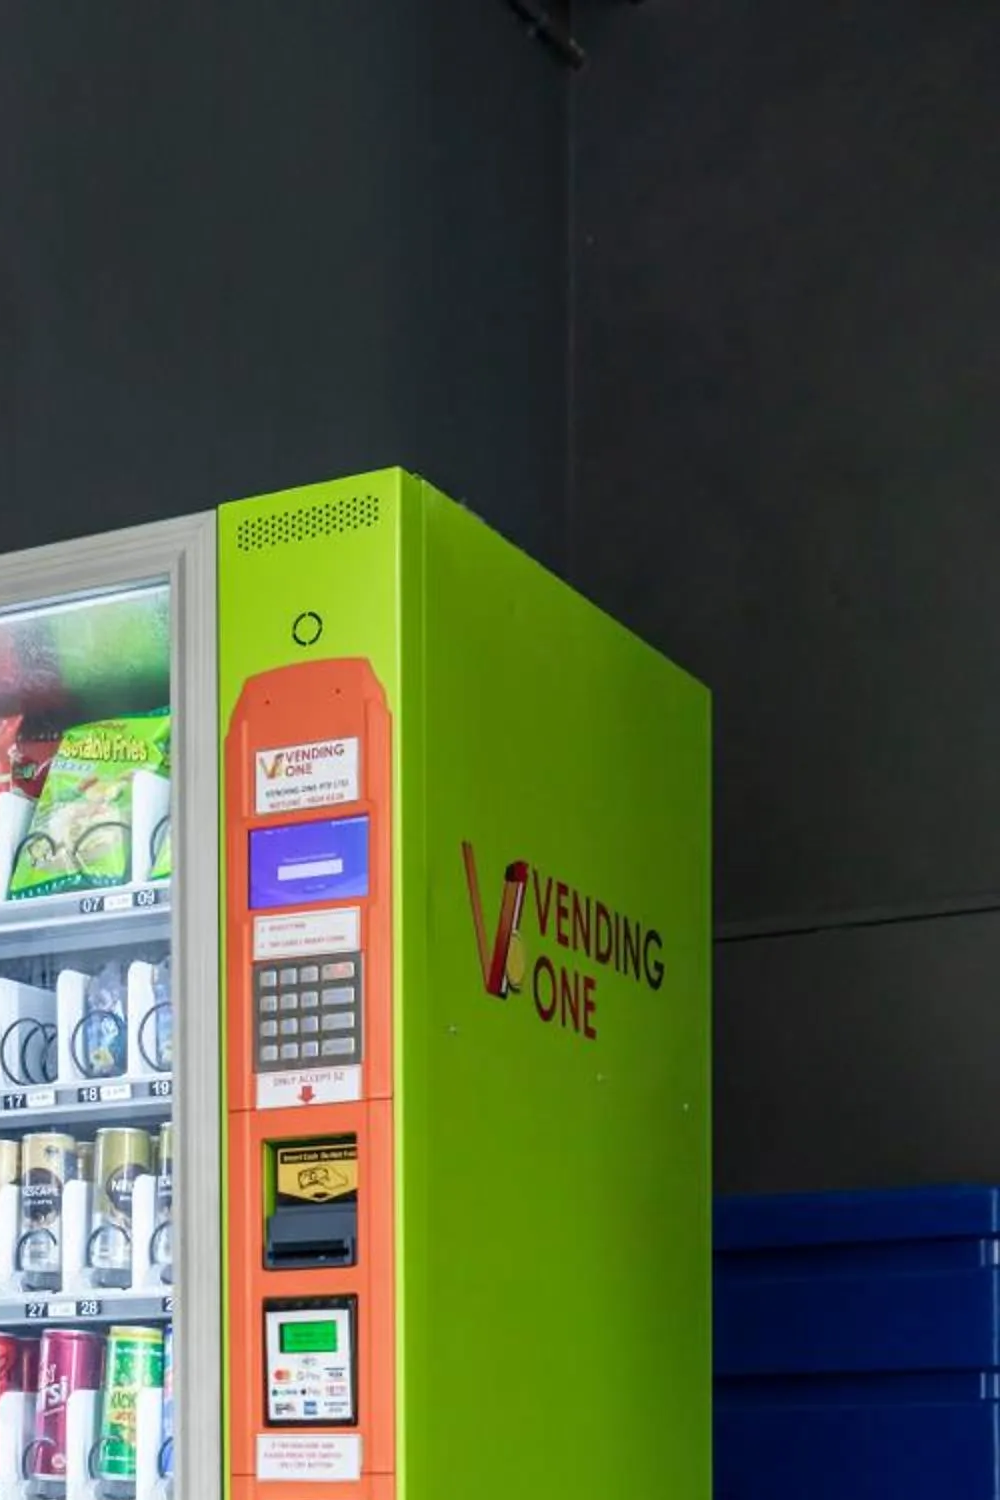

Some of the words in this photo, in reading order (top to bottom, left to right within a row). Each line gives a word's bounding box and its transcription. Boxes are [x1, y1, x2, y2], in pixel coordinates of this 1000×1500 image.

[113, 735, 147, 762] Fries
[285, 743, 345, 762] VENDING
[285, 763, 313, 777] ONE
[82, 898, 100, 912] 07
[532, 867, 664, 990] VENDING
[533, 955, 597, 1040] ONE
[81, 1088, 97, 1100] 18
[152, 1082, 169, 1094] 19
[7, 1095, 23, 1107] 17
[29, 1304, 44, 1317] 27
[81, 1302, 97, 1315] 28
